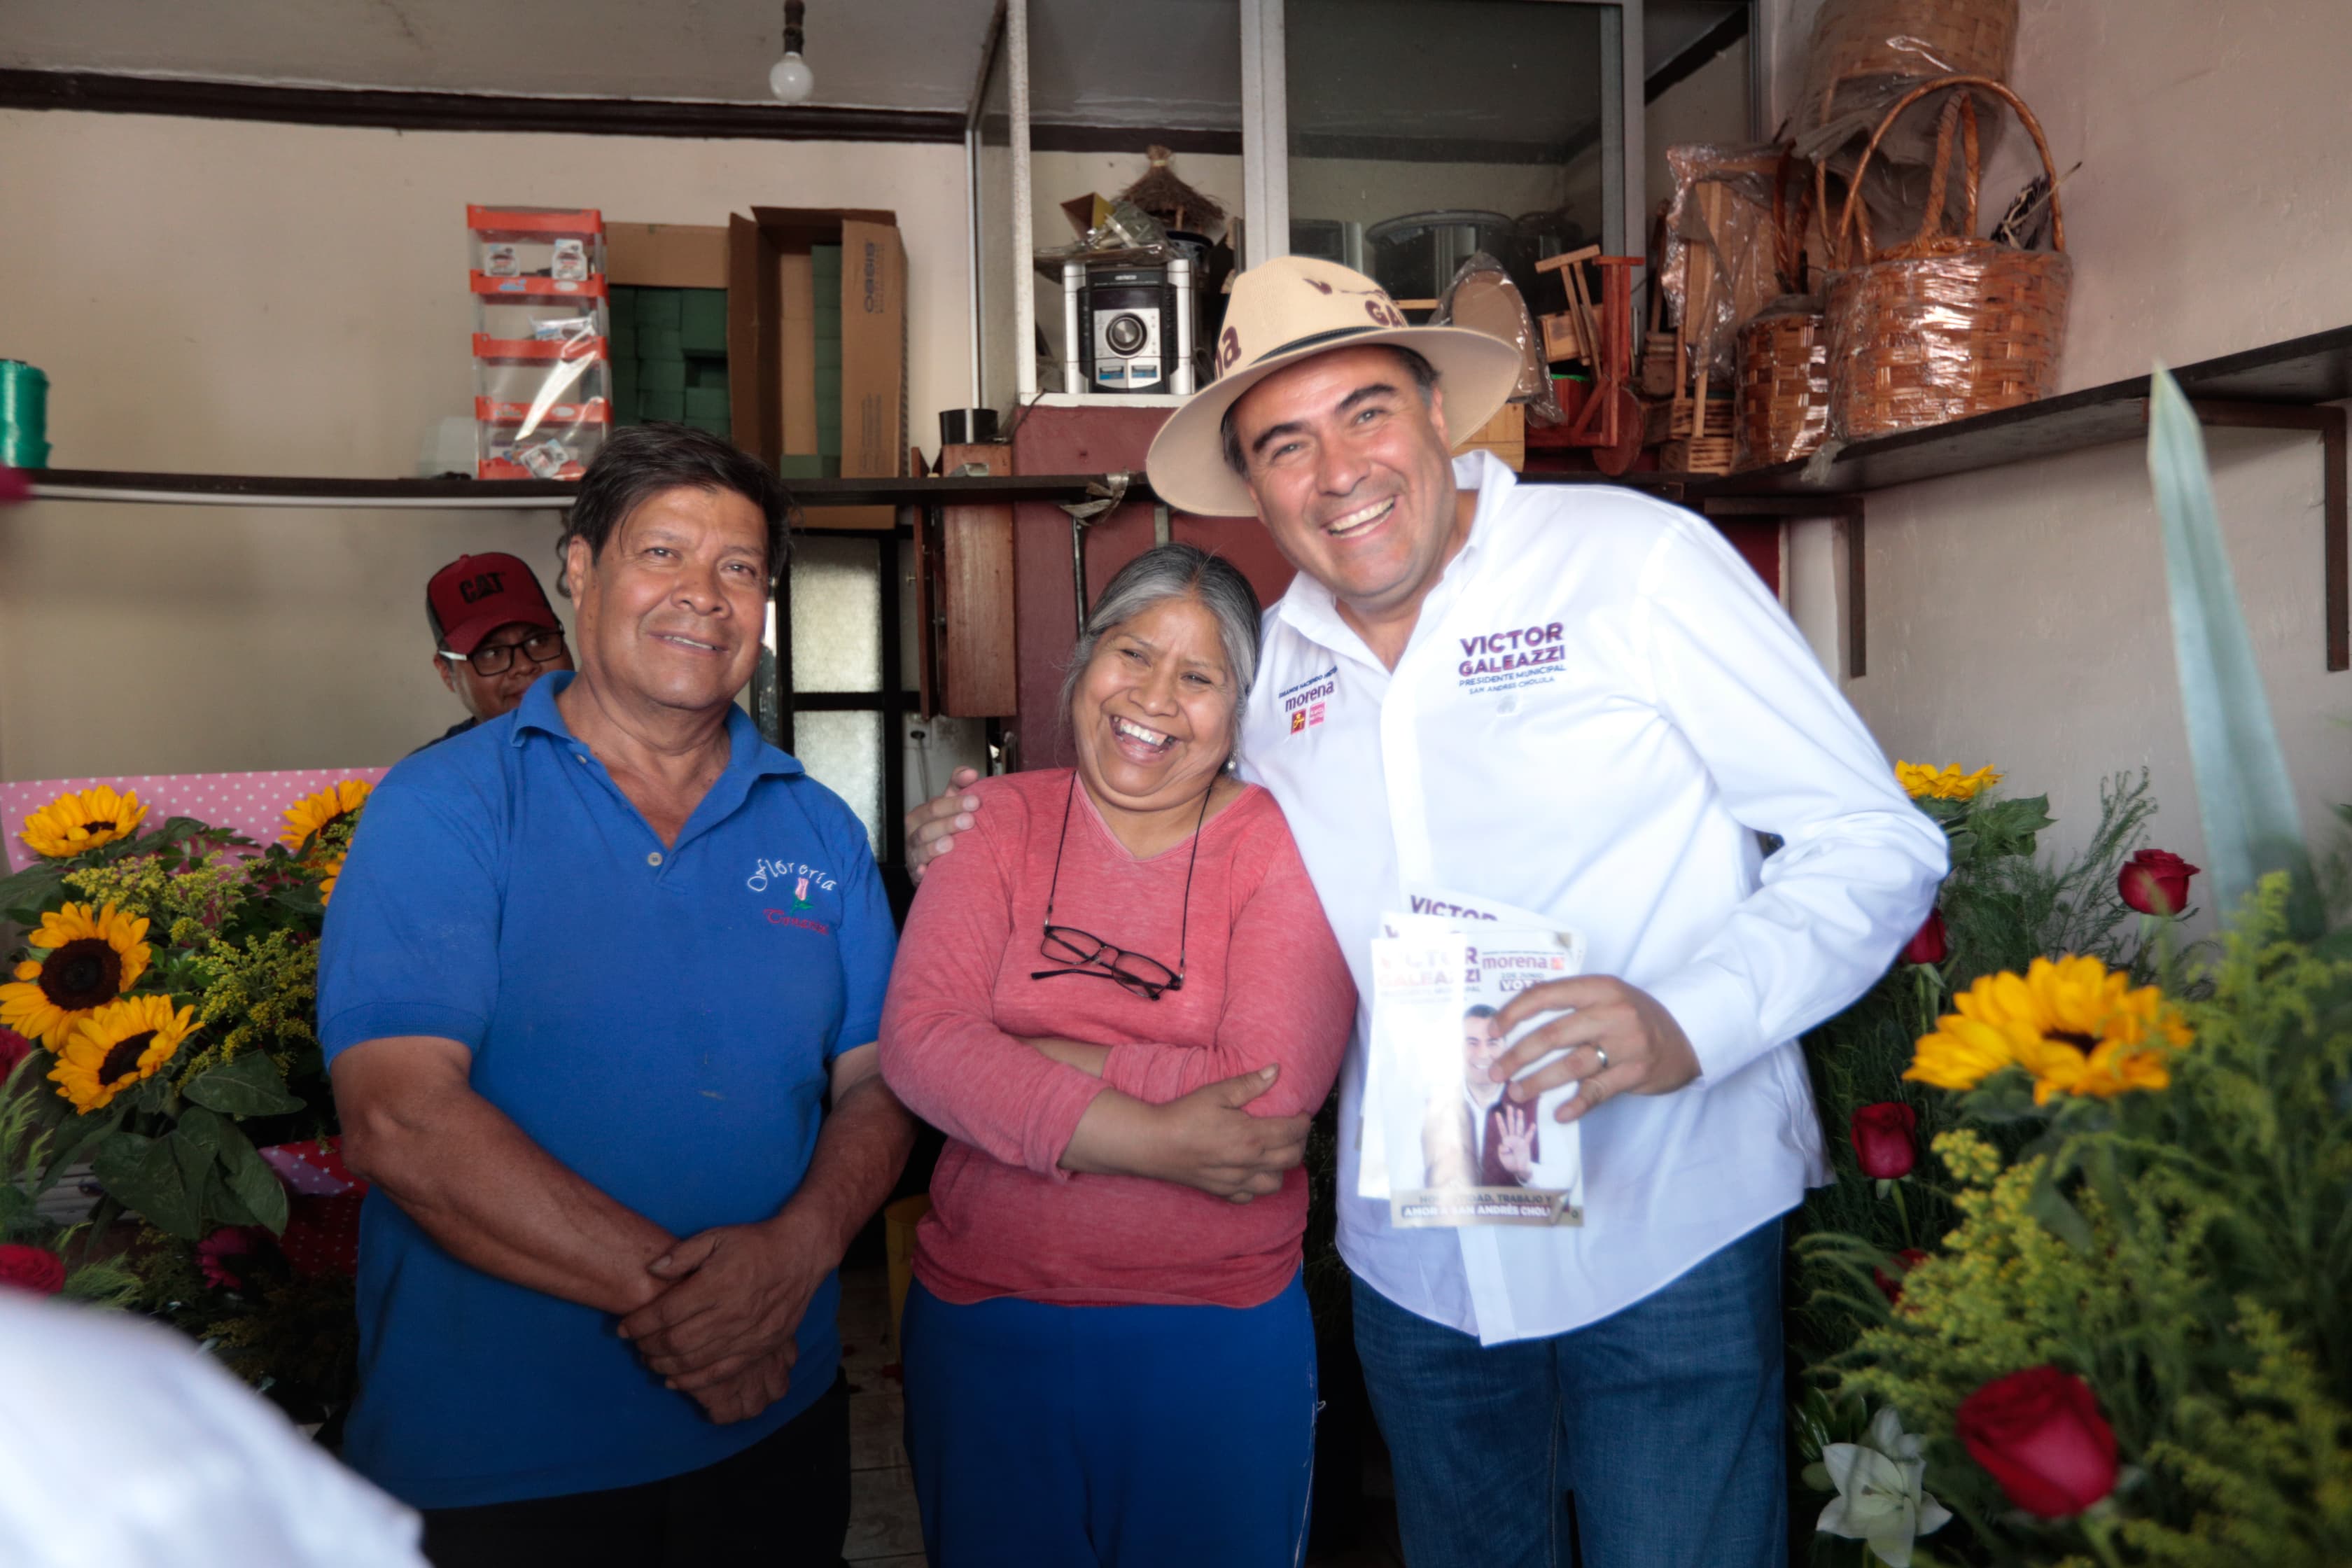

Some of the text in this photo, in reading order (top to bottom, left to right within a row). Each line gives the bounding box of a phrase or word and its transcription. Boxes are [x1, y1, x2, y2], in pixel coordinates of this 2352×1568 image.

[459, 572, 504, 604] CAT
[1460, 622, 1563, 657] VICTOR
[1459, 645, 1565, 677] GALEAZZI
[1460, 664, 1567, 687] PRESIDENTE MUNICIPAL
[1285, 681, 1334, 713] morena
[1483, 956, 1548, 970] morena
[1502, 979, 1538, 990] VOT
[1404, 1205, 1438, 1216] AMOR
[1478, 1203, 1519, 1216] ANDRÉS
[1497, 1194, 1543, 1203] TRABAJO
